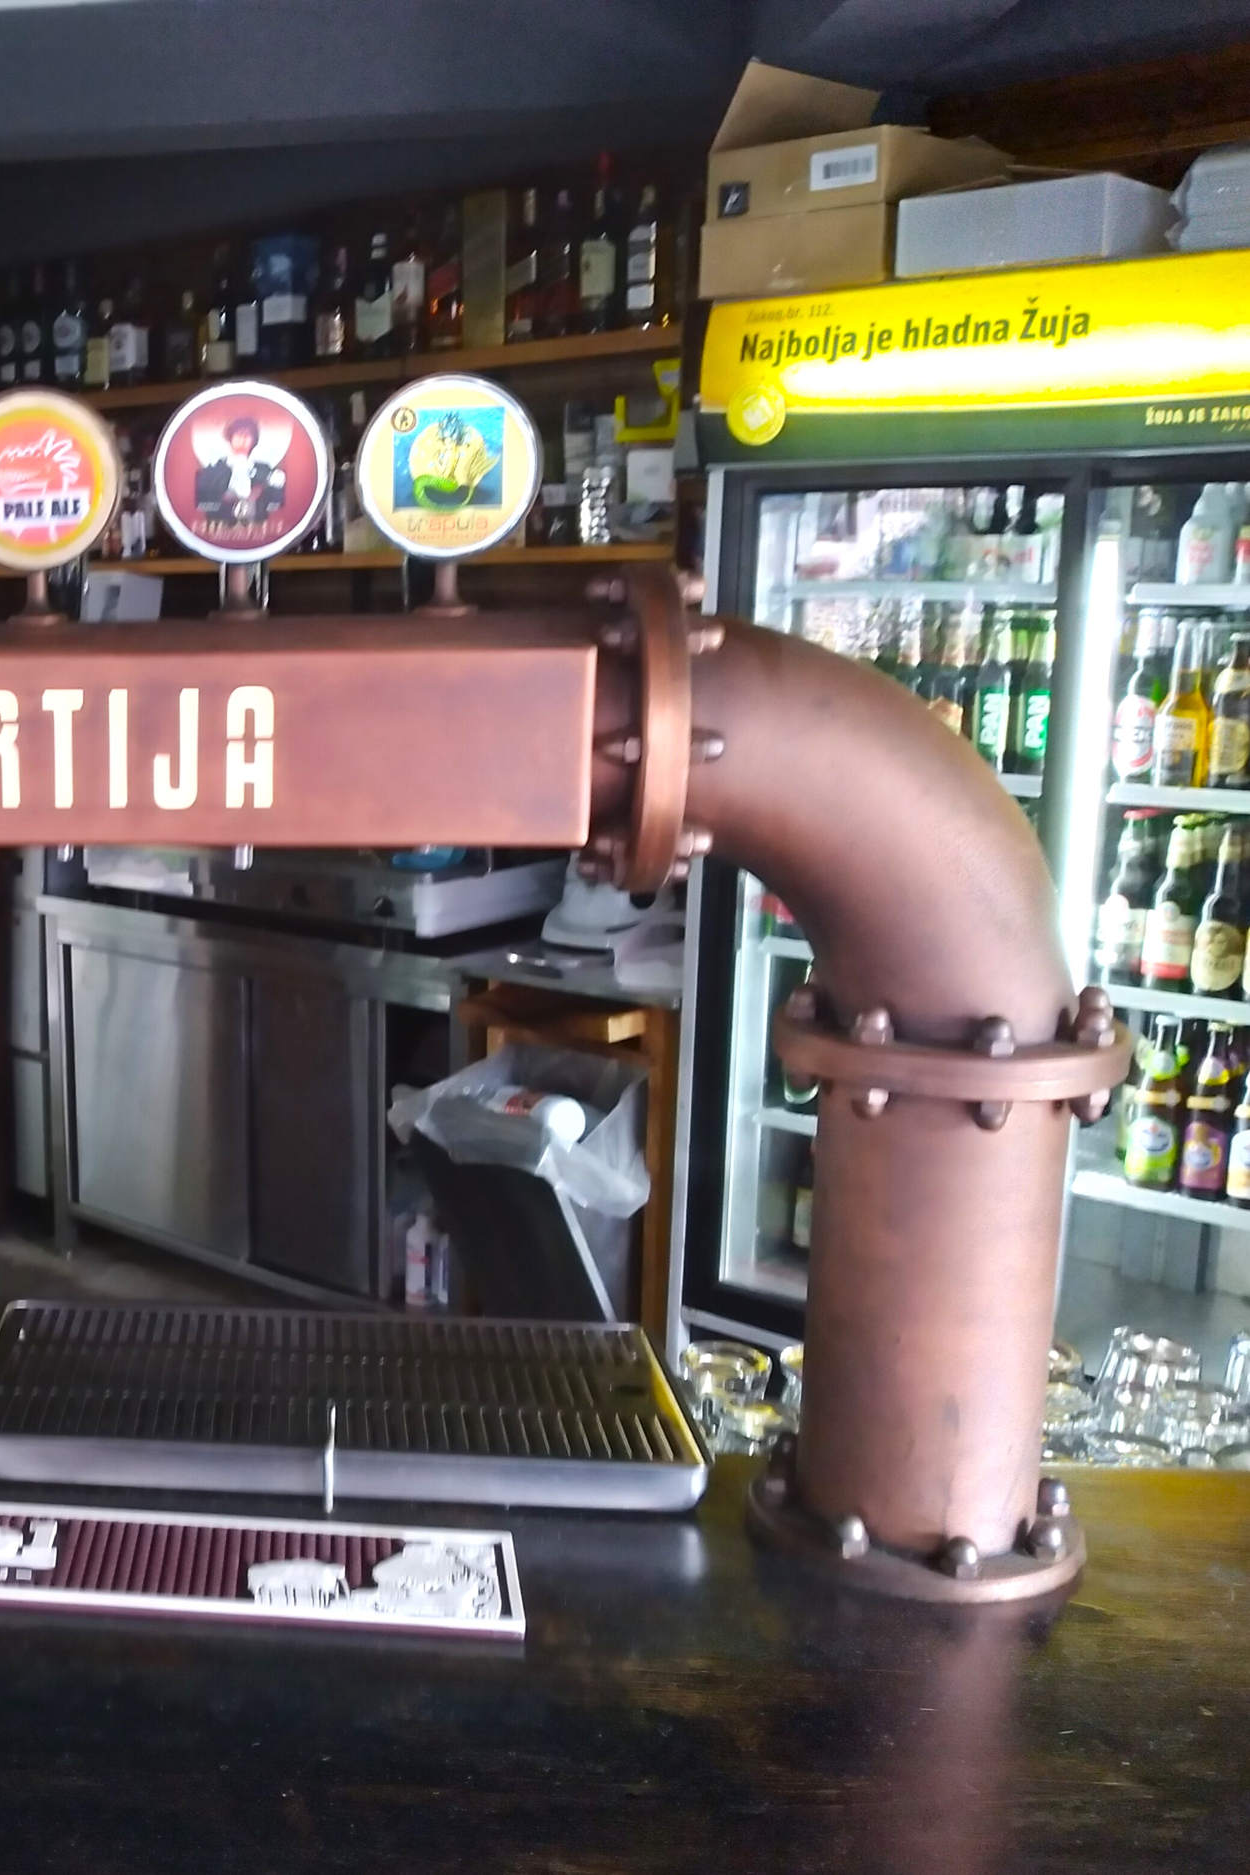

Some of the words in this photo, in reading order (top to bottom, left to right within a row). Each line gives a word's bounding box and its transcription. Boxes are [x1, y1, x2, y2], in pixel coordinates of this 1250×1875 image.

[740, 325, 857, 366] Najbolja
[862, 322, 893, 360] je
[903, 313, 1010, 350] hladna
[1019, 296, 1092, 346] Žuja
[3, 500, 45, 521] PALE
[51, 498, 81, 518] ALE
[980, 693, 1003, 745] PAN
[1025, 695, 1050, 748] PAN
